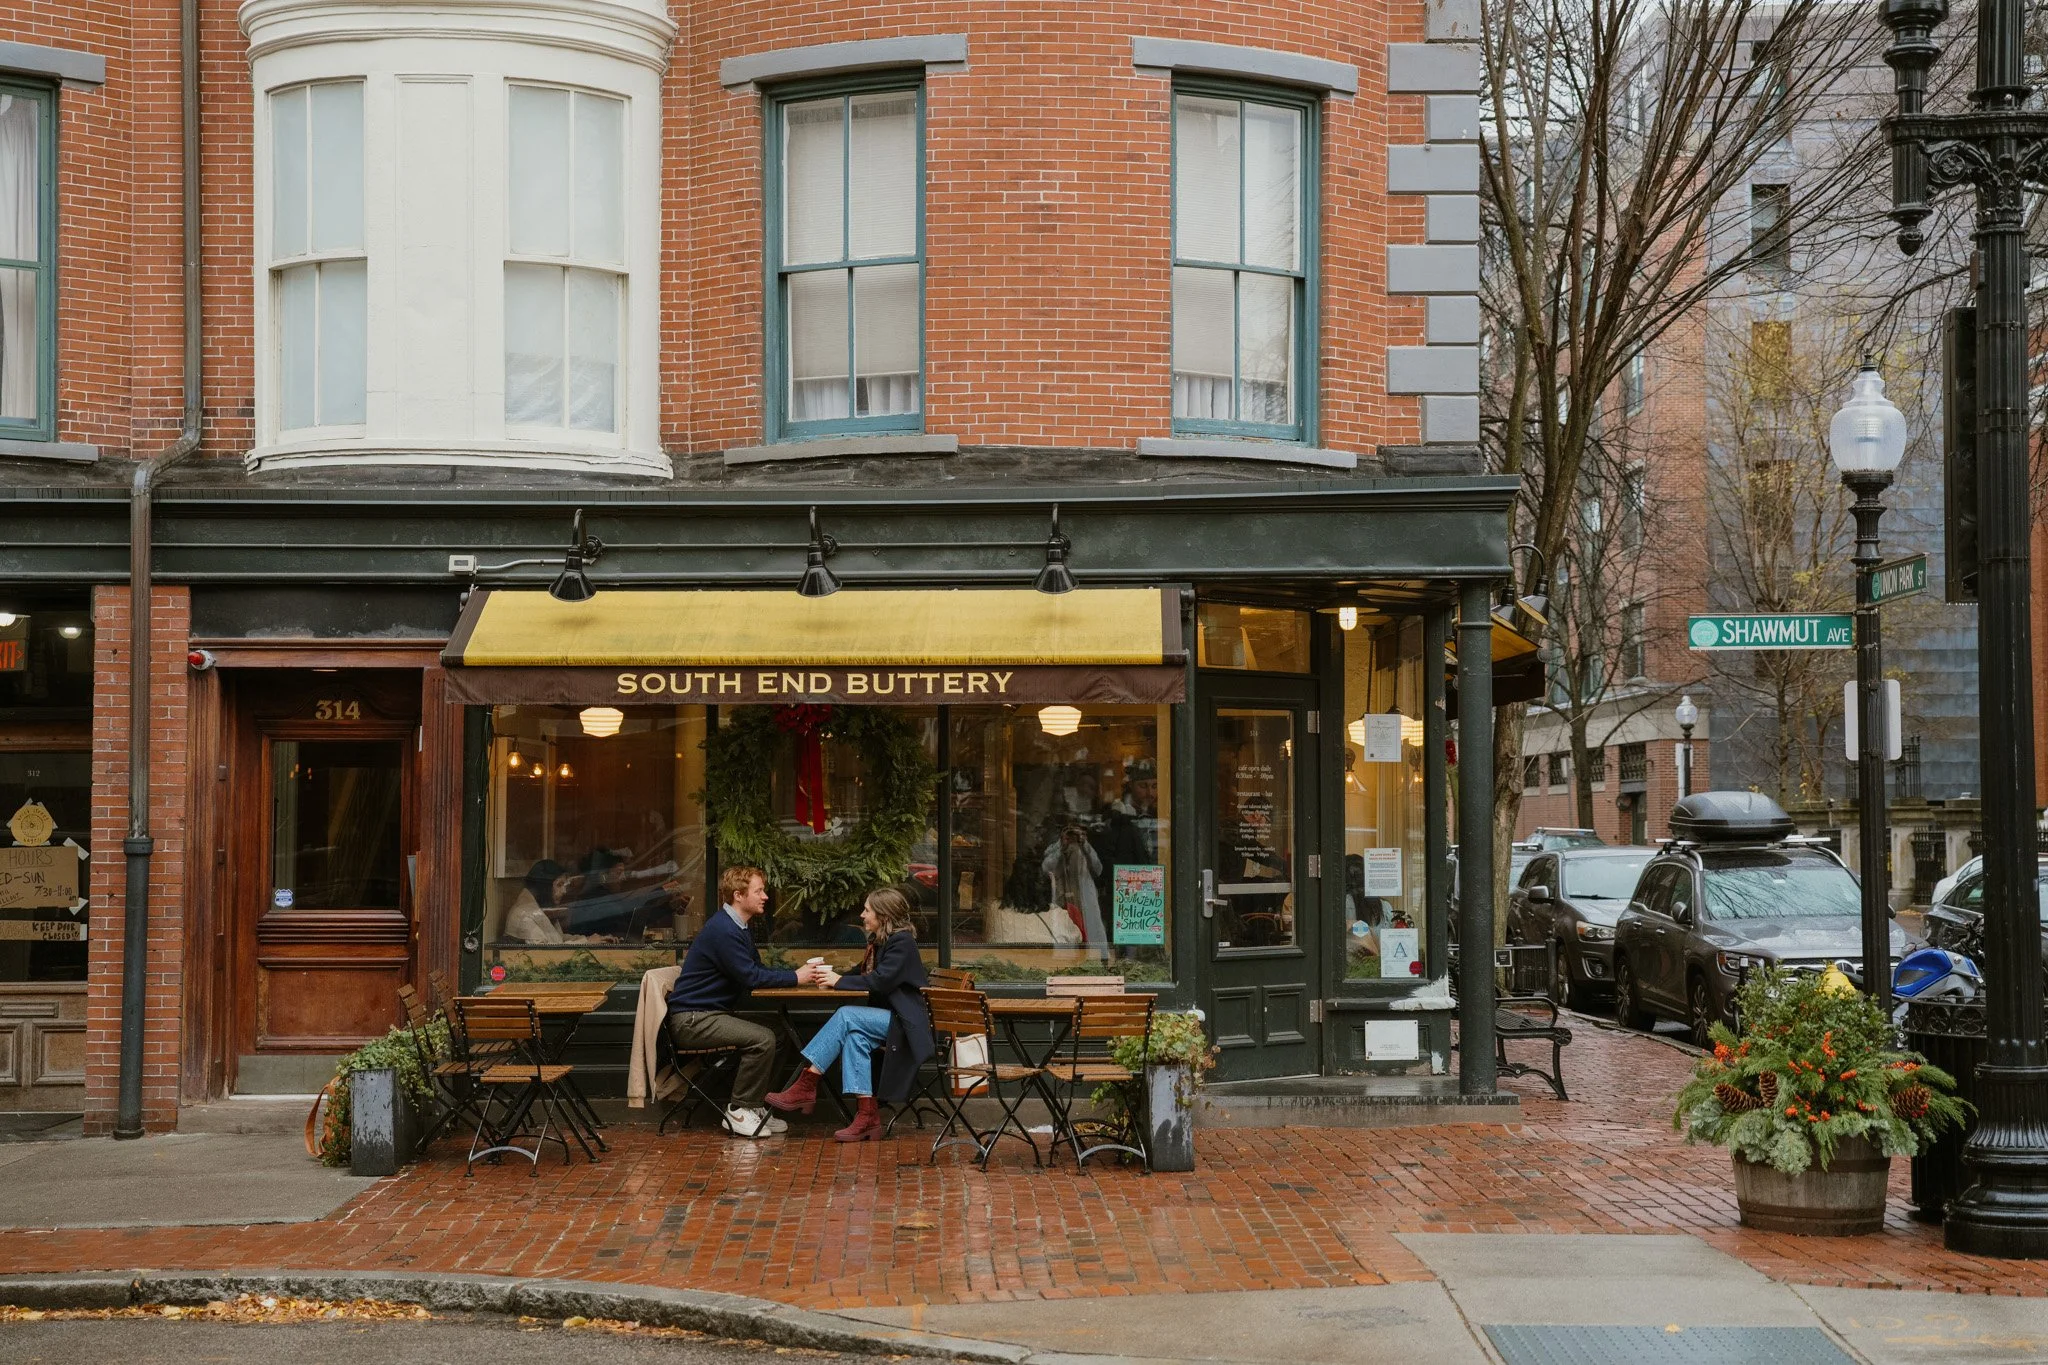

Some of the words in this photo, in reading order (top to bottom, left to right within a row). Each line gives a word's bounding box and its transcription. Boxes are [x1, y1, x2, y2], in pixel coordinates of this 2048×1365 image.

[1880, 568, 1898, 597] UNION
[1899, 564, 1914, 591] PARK
[1918, 570, 1924, 586] ST
[1722, 618, 1822, 644] SHAWMUT
[1826, 628, 1850, 642] AVE
[616, 672, 742, 694] SOUTH
[757, 672, 833, 694] END
[846, 671, 1014, 694] BUTTERY
[314, 700, 361, 720] 314
[9, 849, 53, 866] HOURS
[1143, 897, 1162, 908] END
[1118, 904, 1160, 919] Holiday
[32, 922, 55, 932] KEEP
[57, 922, 76, 932] DOOR
[1120, 918, 1145, 930] Stroll
[42, 932, 71, 940] CLOSED
[1394, 942, 1408, 958] A
